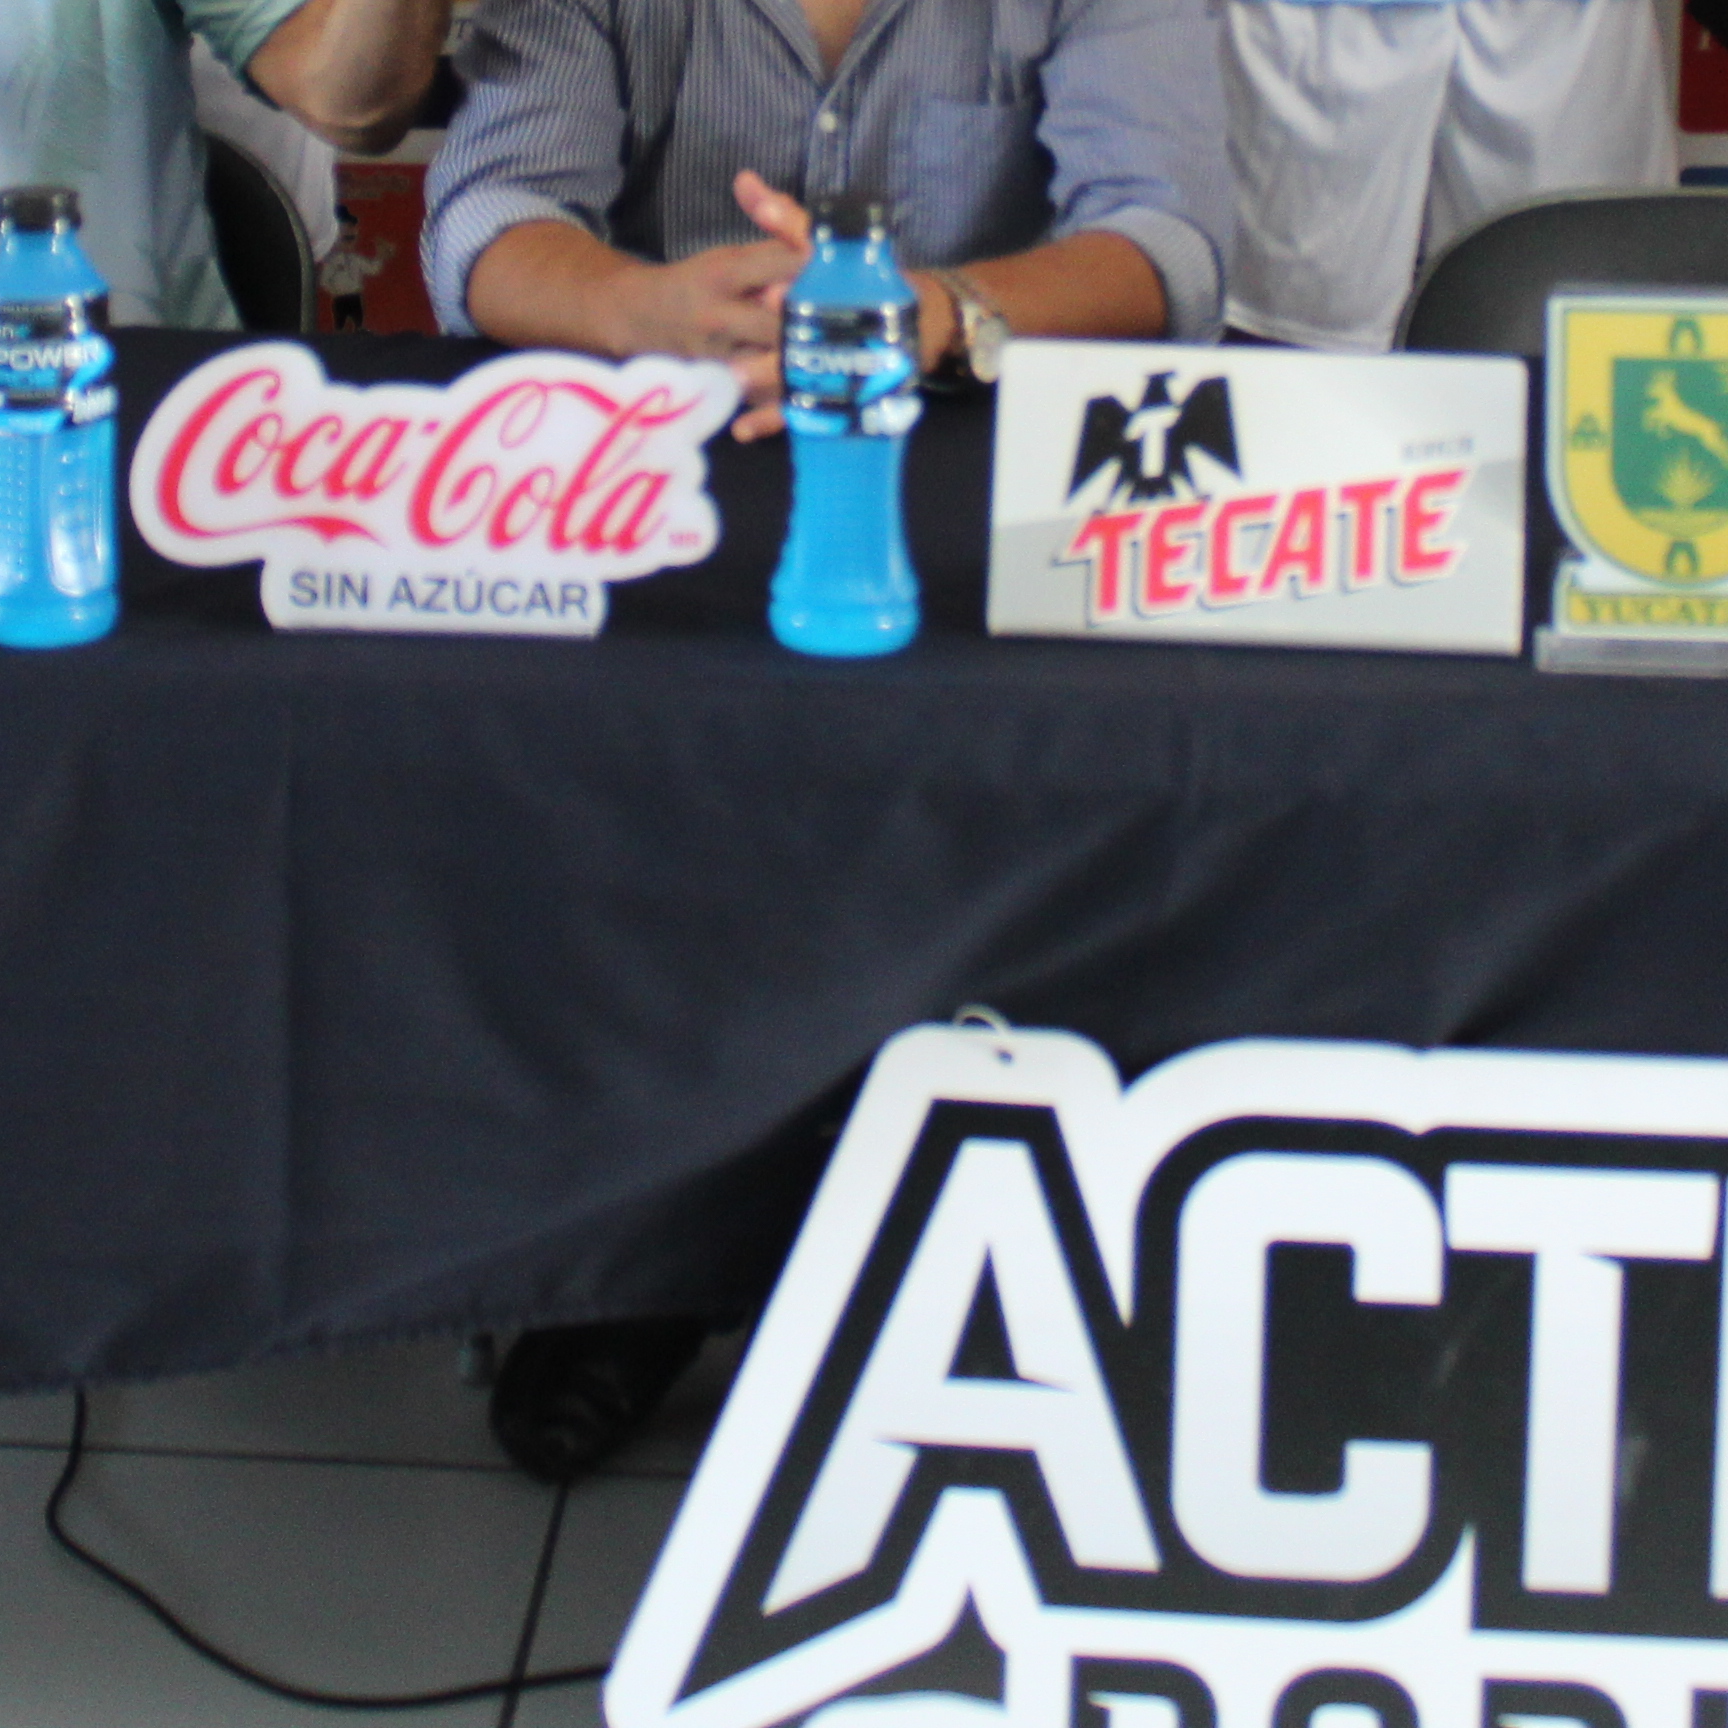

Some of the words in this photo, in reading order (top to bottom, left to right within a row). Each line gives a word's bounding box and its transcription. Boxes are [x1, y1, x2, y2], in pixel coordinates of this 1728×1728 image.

[157, 365, 704, 559] Coca-Cola
[288, 569, 371, 608] SIN
[387, 566, 589, 618] AZÚCAR
[1053, 467, 1470, 628] TECATE
